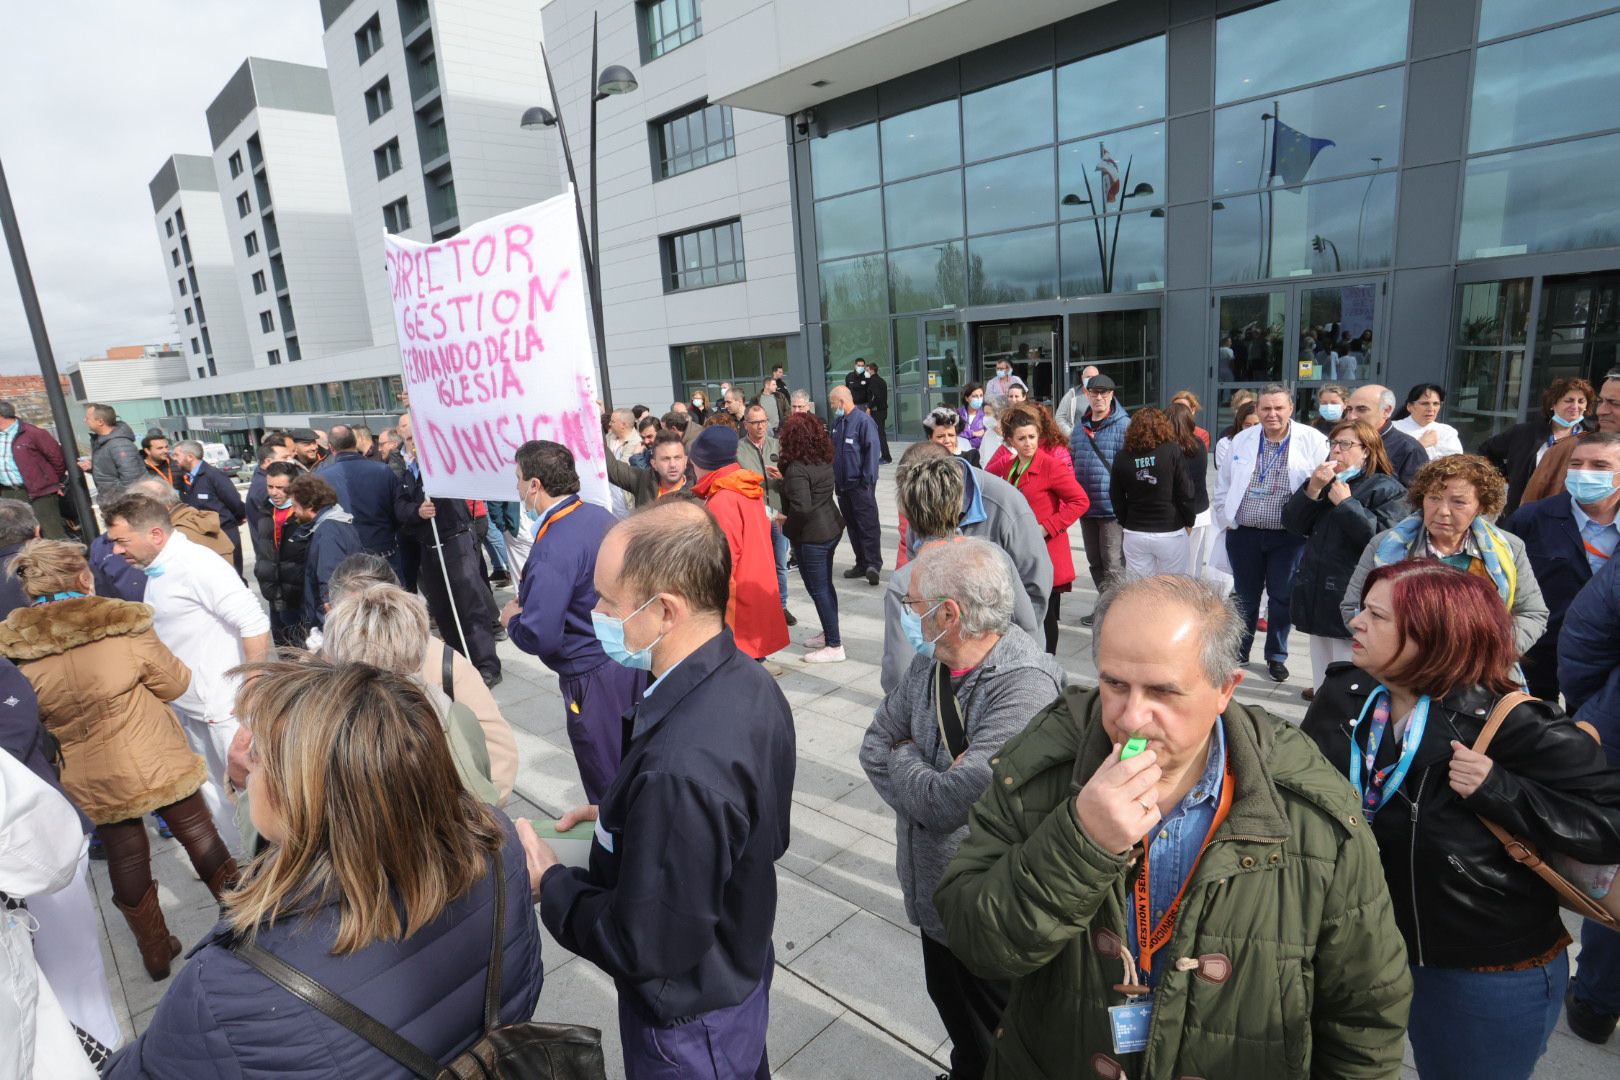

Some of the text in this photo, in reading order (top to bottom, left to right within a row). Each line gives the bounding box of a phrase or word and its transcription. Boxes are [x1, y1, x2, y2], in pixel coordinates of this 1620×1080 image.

[386, 224, 534, 302] DIRECTOR
[436, 360, 525, 407] IGLESIA
[1135, 456, 1156, 469] TERT
